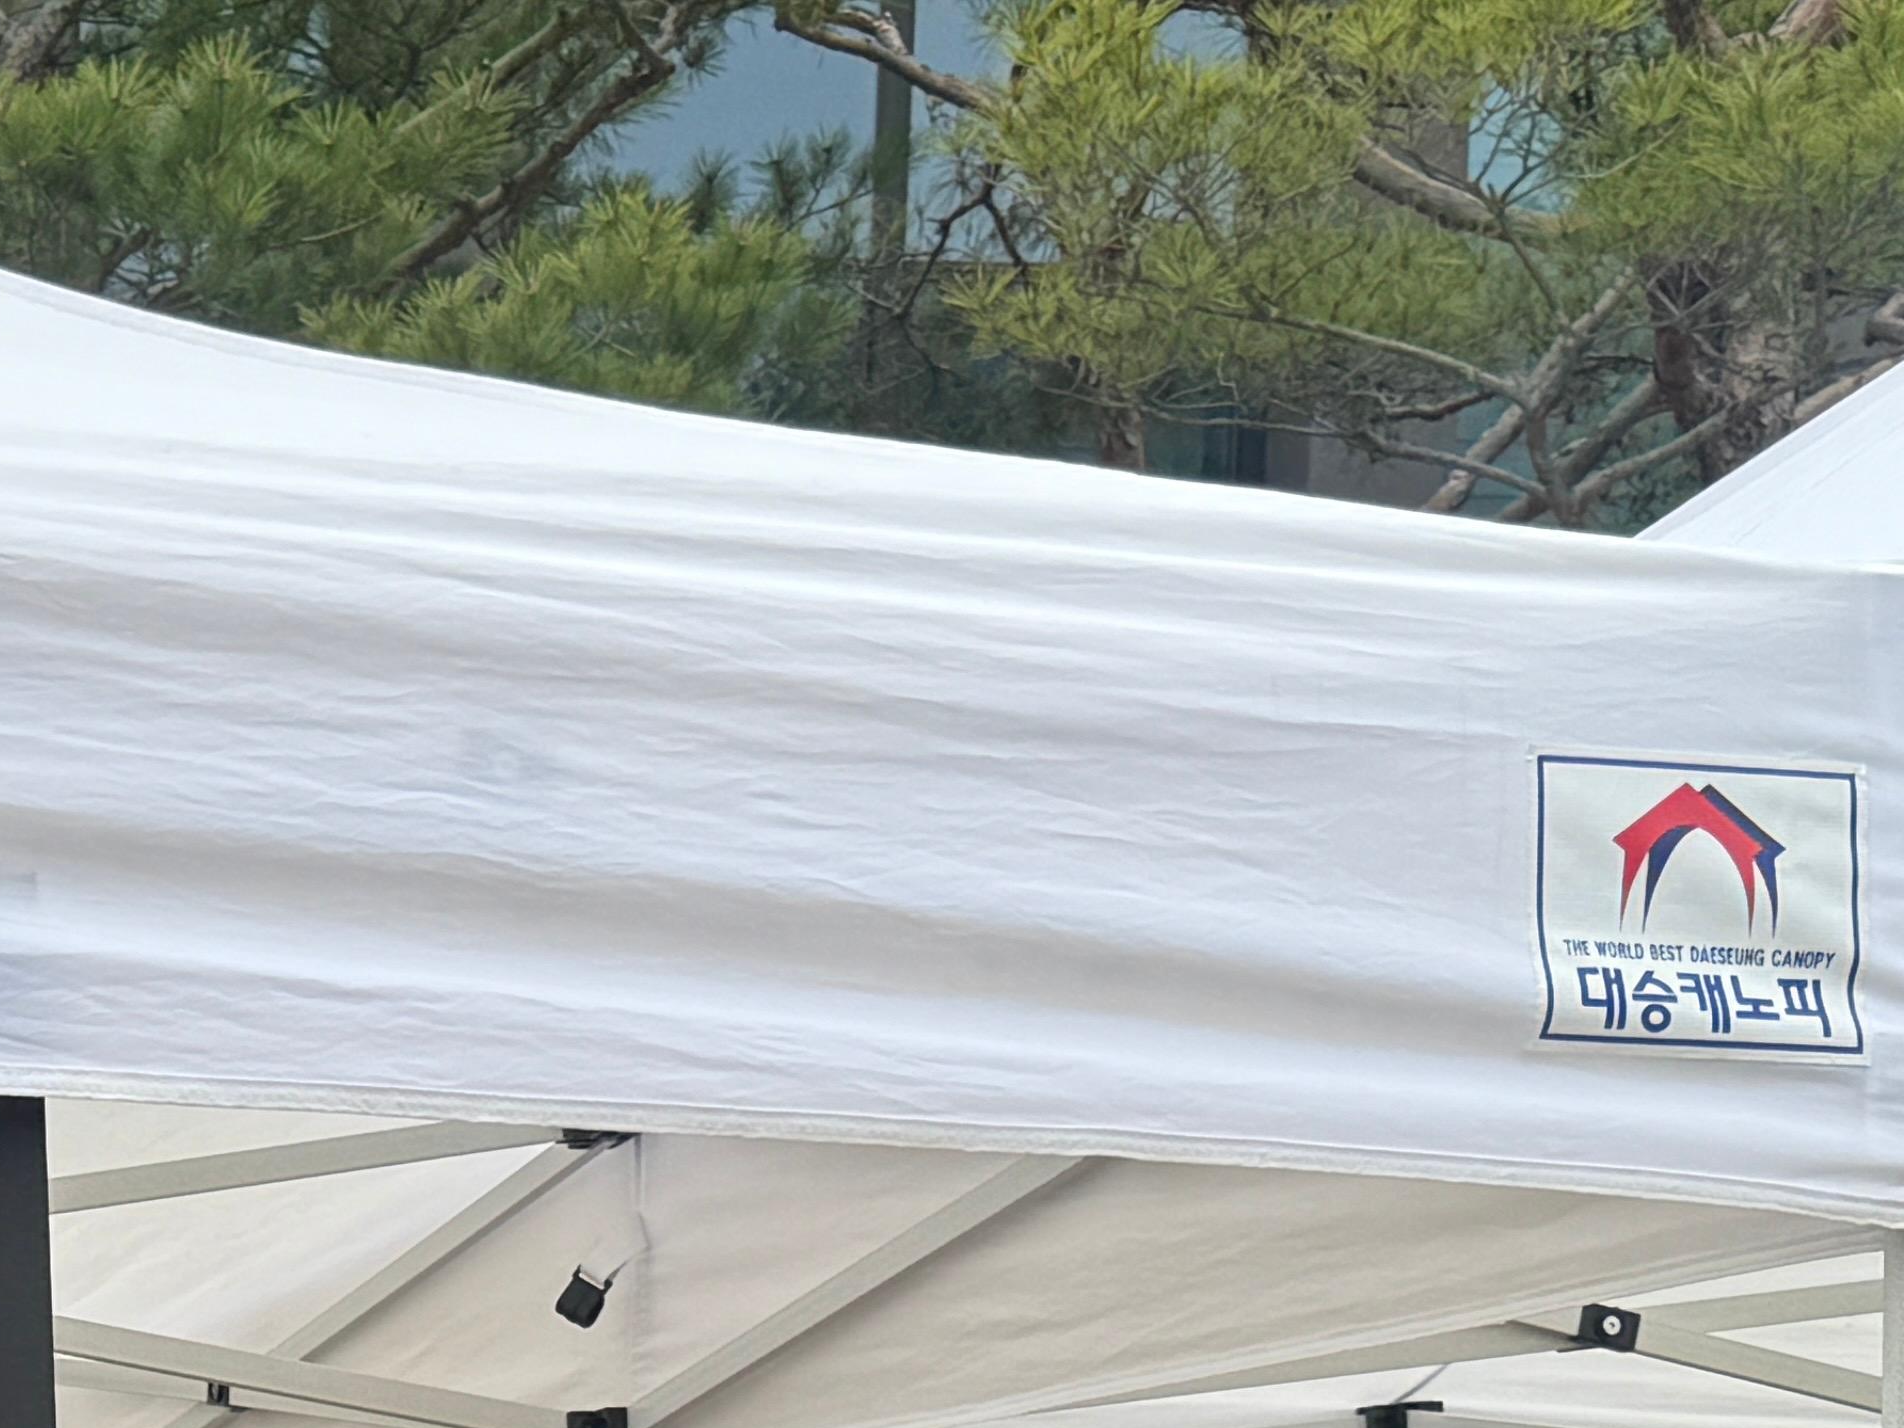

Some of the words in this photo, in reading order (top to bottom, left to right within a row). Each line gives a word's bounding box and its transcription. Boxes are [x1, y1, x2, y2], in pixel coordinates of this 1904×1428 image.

[1563, 939, 1590, 956] THE
[1595, 940, 1642, 960] WORLD
[1649, 944, 1683, 963] BEST
[1690, 946, 1764, 967] DAESEUNG
[1771, 950, 1836, 969] CANOPY
[1576, 966, 1832, 1038] 대승캐노피
